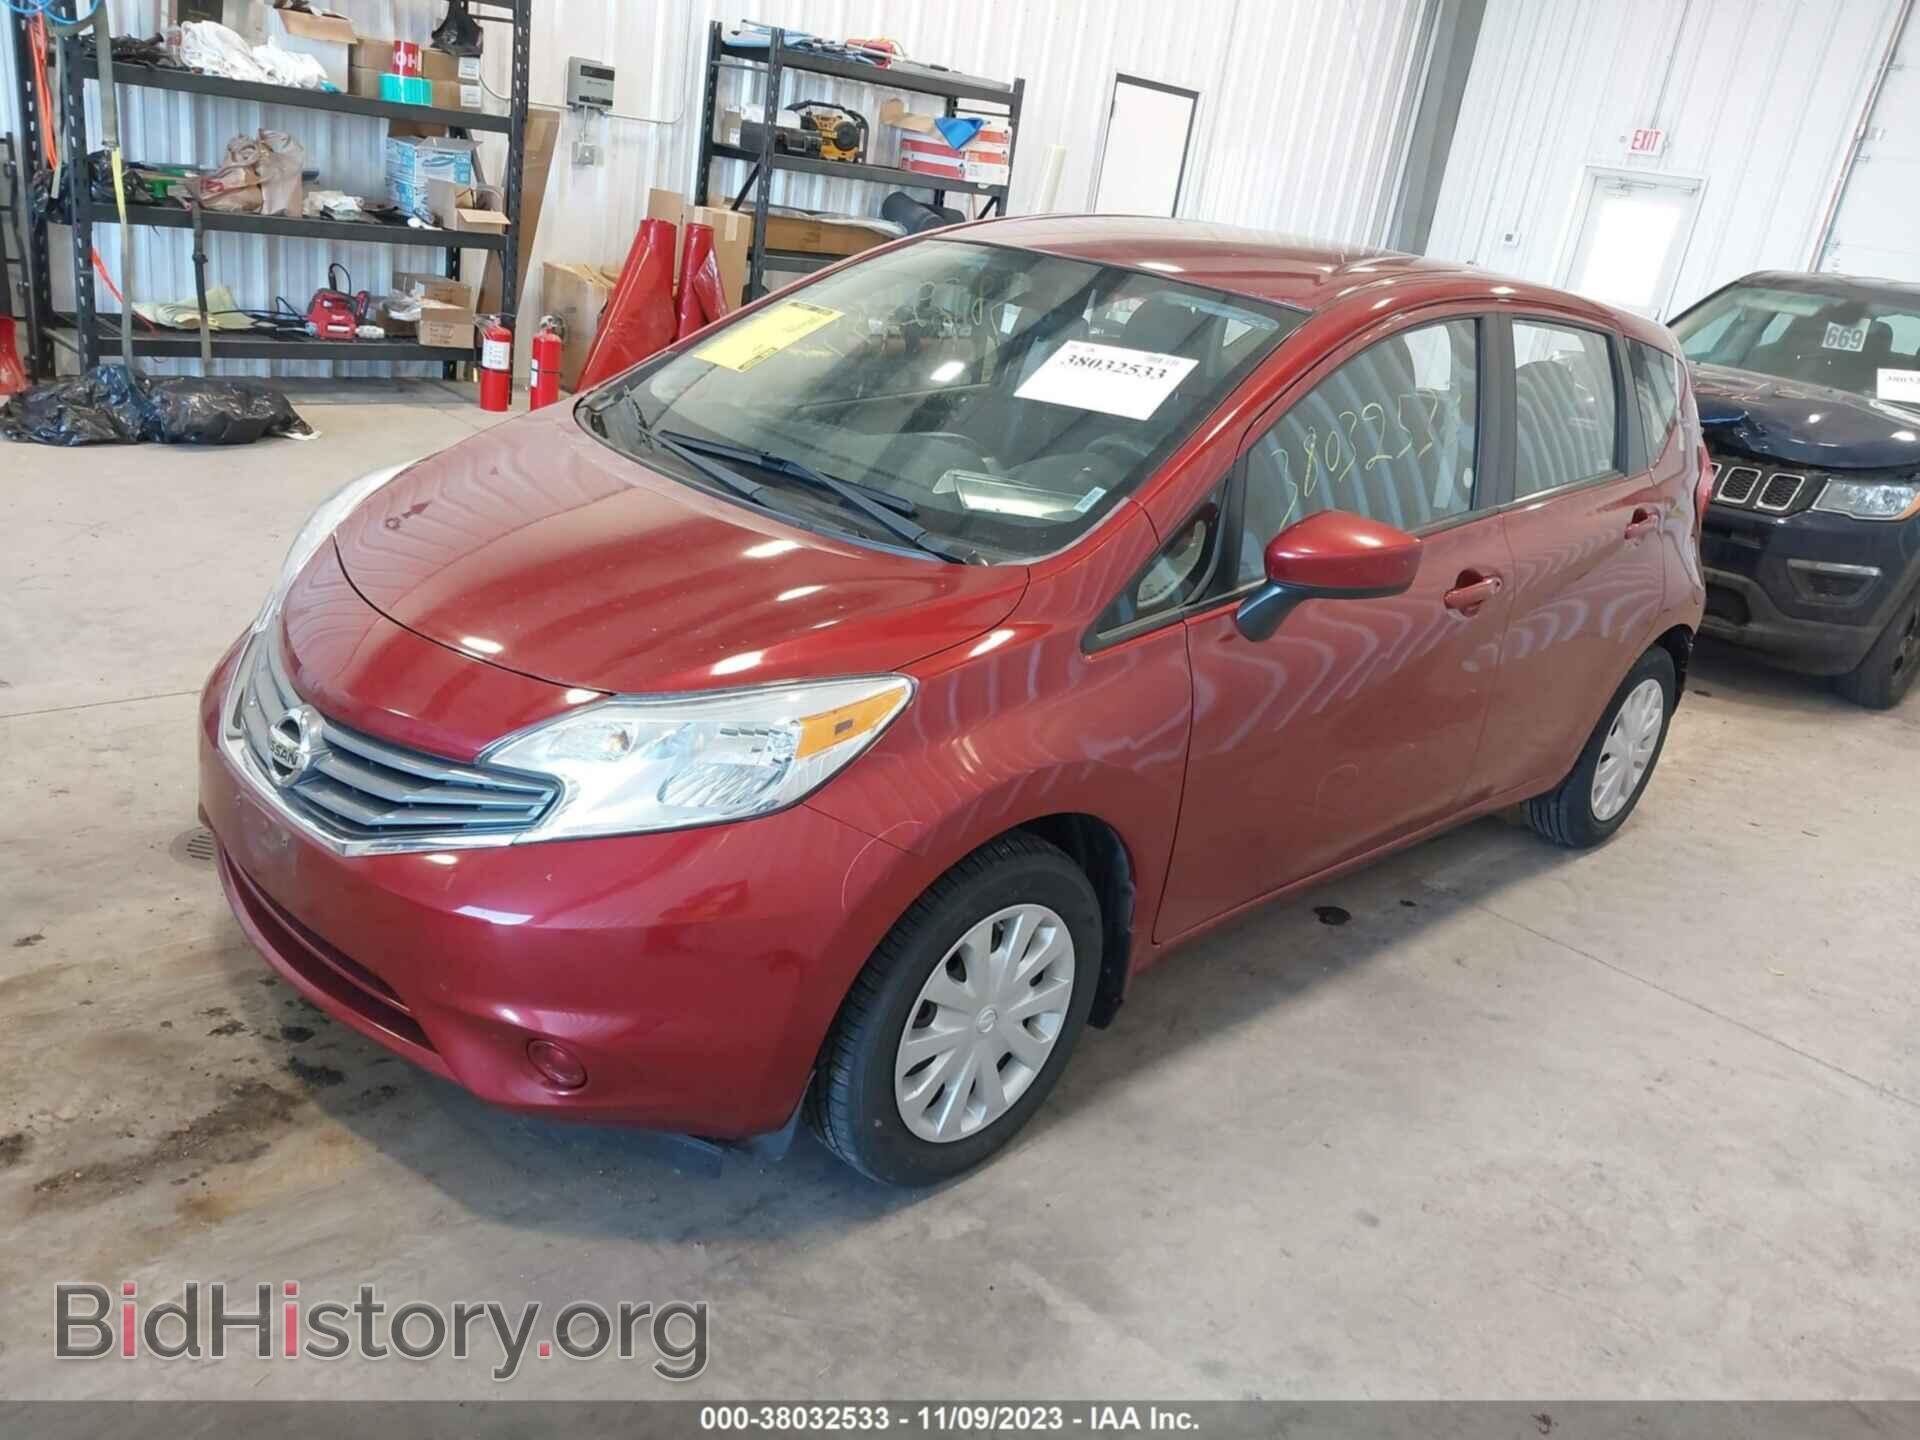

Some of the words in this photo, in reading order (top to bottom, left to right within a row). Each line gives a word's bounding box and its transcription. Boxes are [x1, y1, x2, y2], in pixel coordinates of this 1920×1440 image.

[1631, 129, 1661, 152] EXIT
[1826, 325, 1863, 349] 669
[1061, 353, 1168, 381] 38032533
